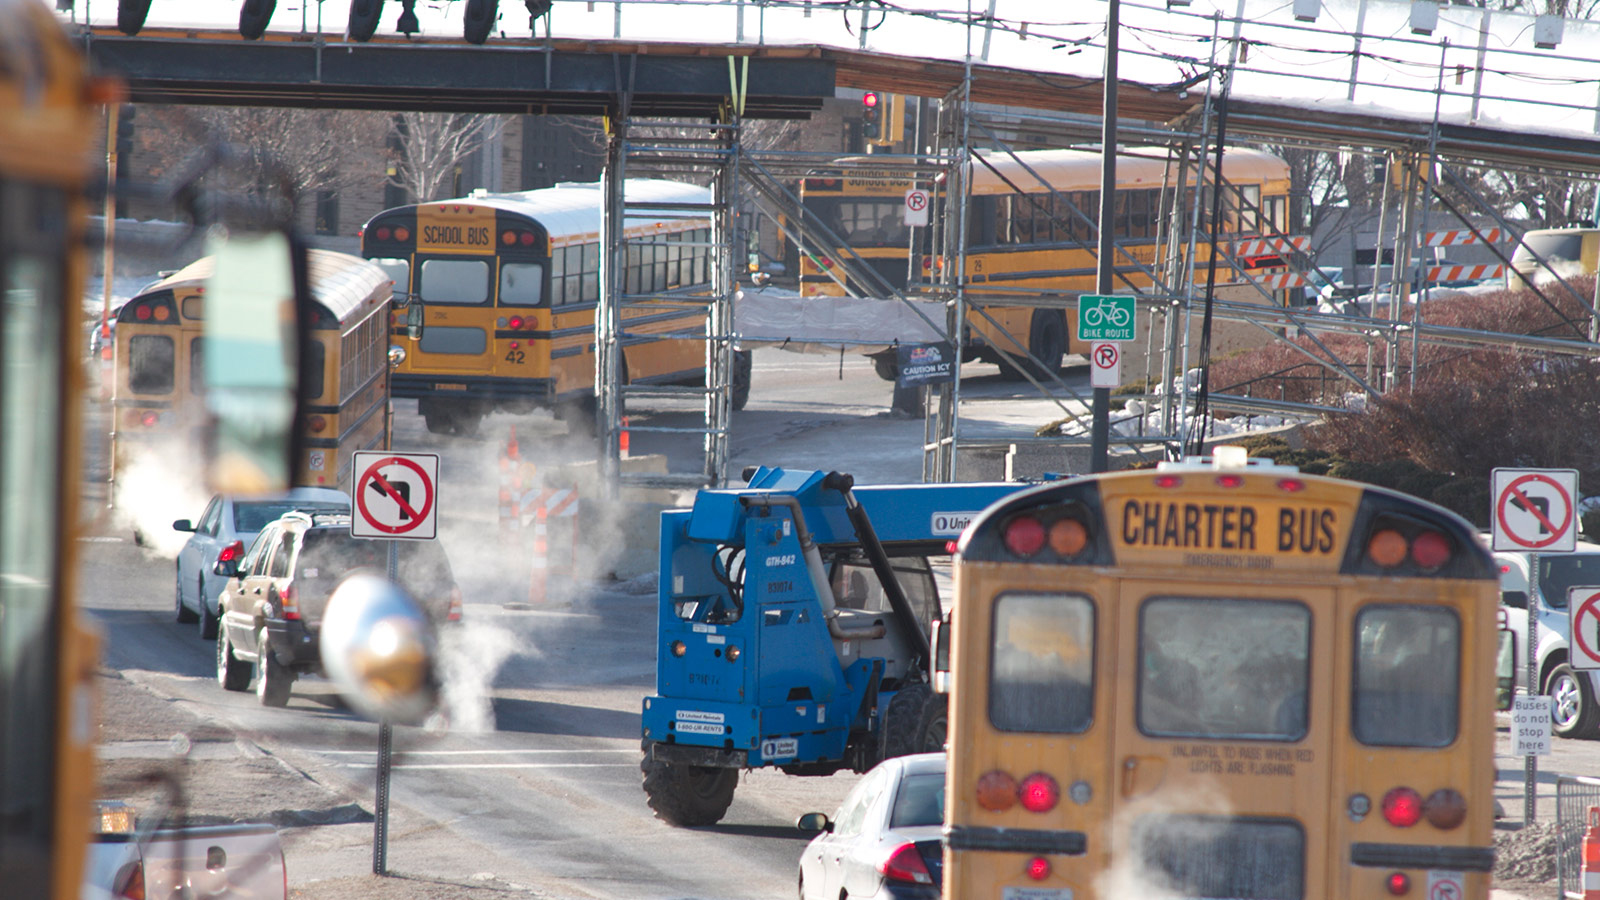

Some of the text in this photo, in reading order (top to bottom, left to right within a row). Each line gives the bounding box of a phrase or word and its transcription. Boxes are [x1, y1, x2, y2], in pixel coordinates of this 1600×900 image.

[424, 226, 489, 245] SCHOOL BUS
[1083, 329, 1130, 338] BIKE ROUTE
[505, 351, 525, 364] 42
[903, 363, 950, 375] CAUTION ICY
[1122, 500, 1336, 553] CHARTER BUS
[765, 554, 796, 567] GTH-842
[1182, 553, 1245, 568] EMERGENCY
[1515, 701, 1548, 710] Buses
[1514, 714, 1549, 724] do not
[1519, 728, 1544, 738] stop
[1518, 740, 1544, 750] here
[1223, 746, 1237, 759] TO
[1239, 746, 1262, 760] PASS
[1227, 761, 1245, 774] ARE
